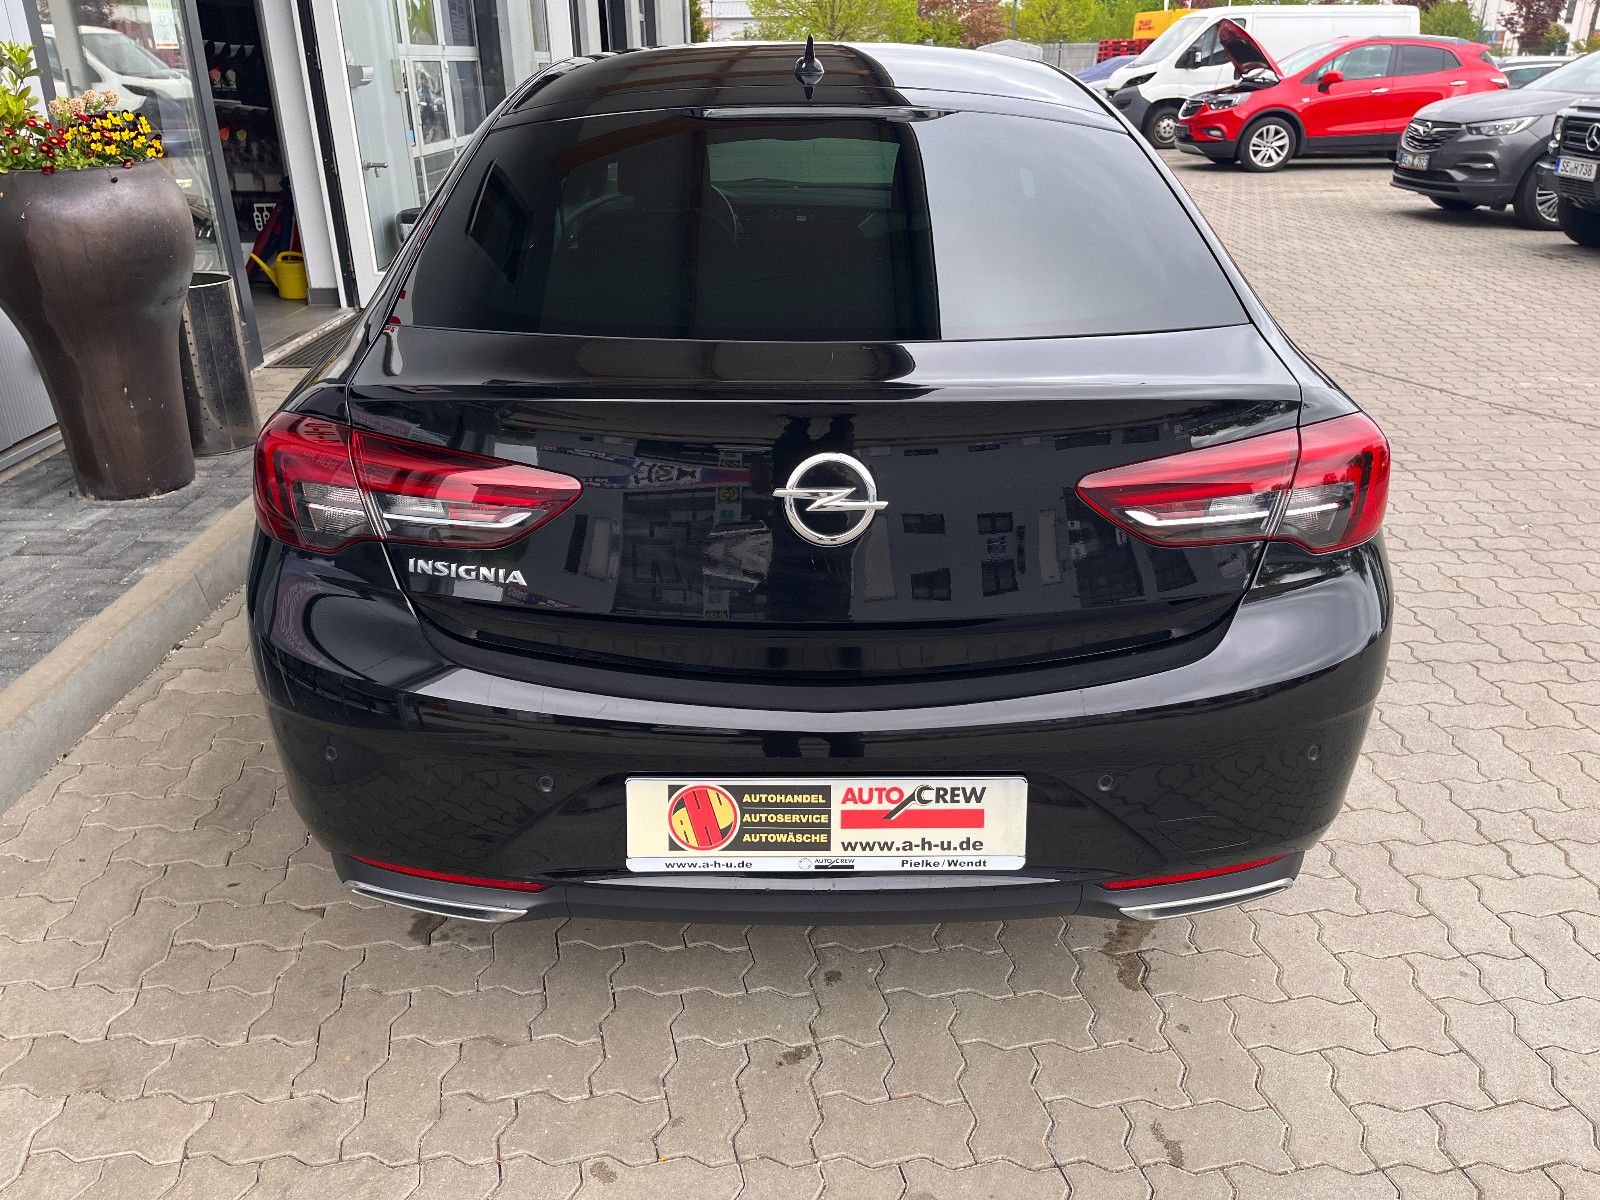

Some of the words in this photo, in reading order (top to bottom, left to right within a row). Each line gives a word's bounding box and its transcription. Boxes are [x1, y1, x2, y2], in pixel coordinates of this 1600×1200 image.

[409, 557, 527, 586] INSIGNIA
[743, 793, 825, 803] AUTOHANDEL
[841, 788, 904, 804] AUTO
[743, 813, 829, 823] AUTOSERVICE
[743, 832, 828, 843] AUTOWÄSCHE
[841, 837, 984, 852] www.a-h-u.de
[665, 860, 753, 869] www.a-h-u.de
